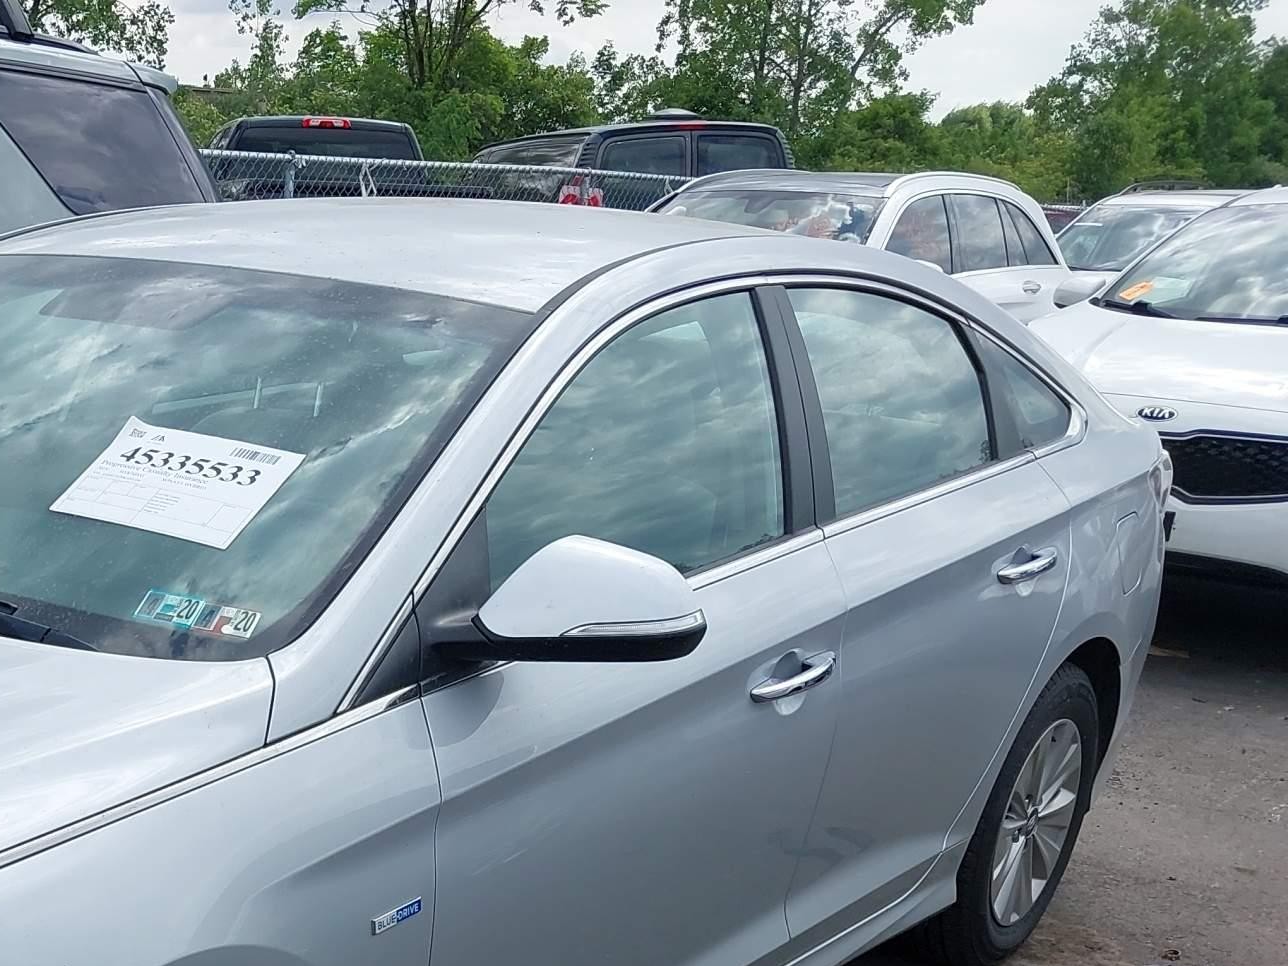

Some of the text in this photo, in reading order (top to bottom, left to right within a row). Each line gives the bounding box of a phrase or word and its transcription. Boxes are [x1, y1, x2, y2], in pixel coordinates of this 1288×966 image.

[1142, 407, 1170, 418] KIA
[120, 446, 261, 486] 45335533
[176, 599, 200, 620] 20
[232, 611, 257, 633] 20
